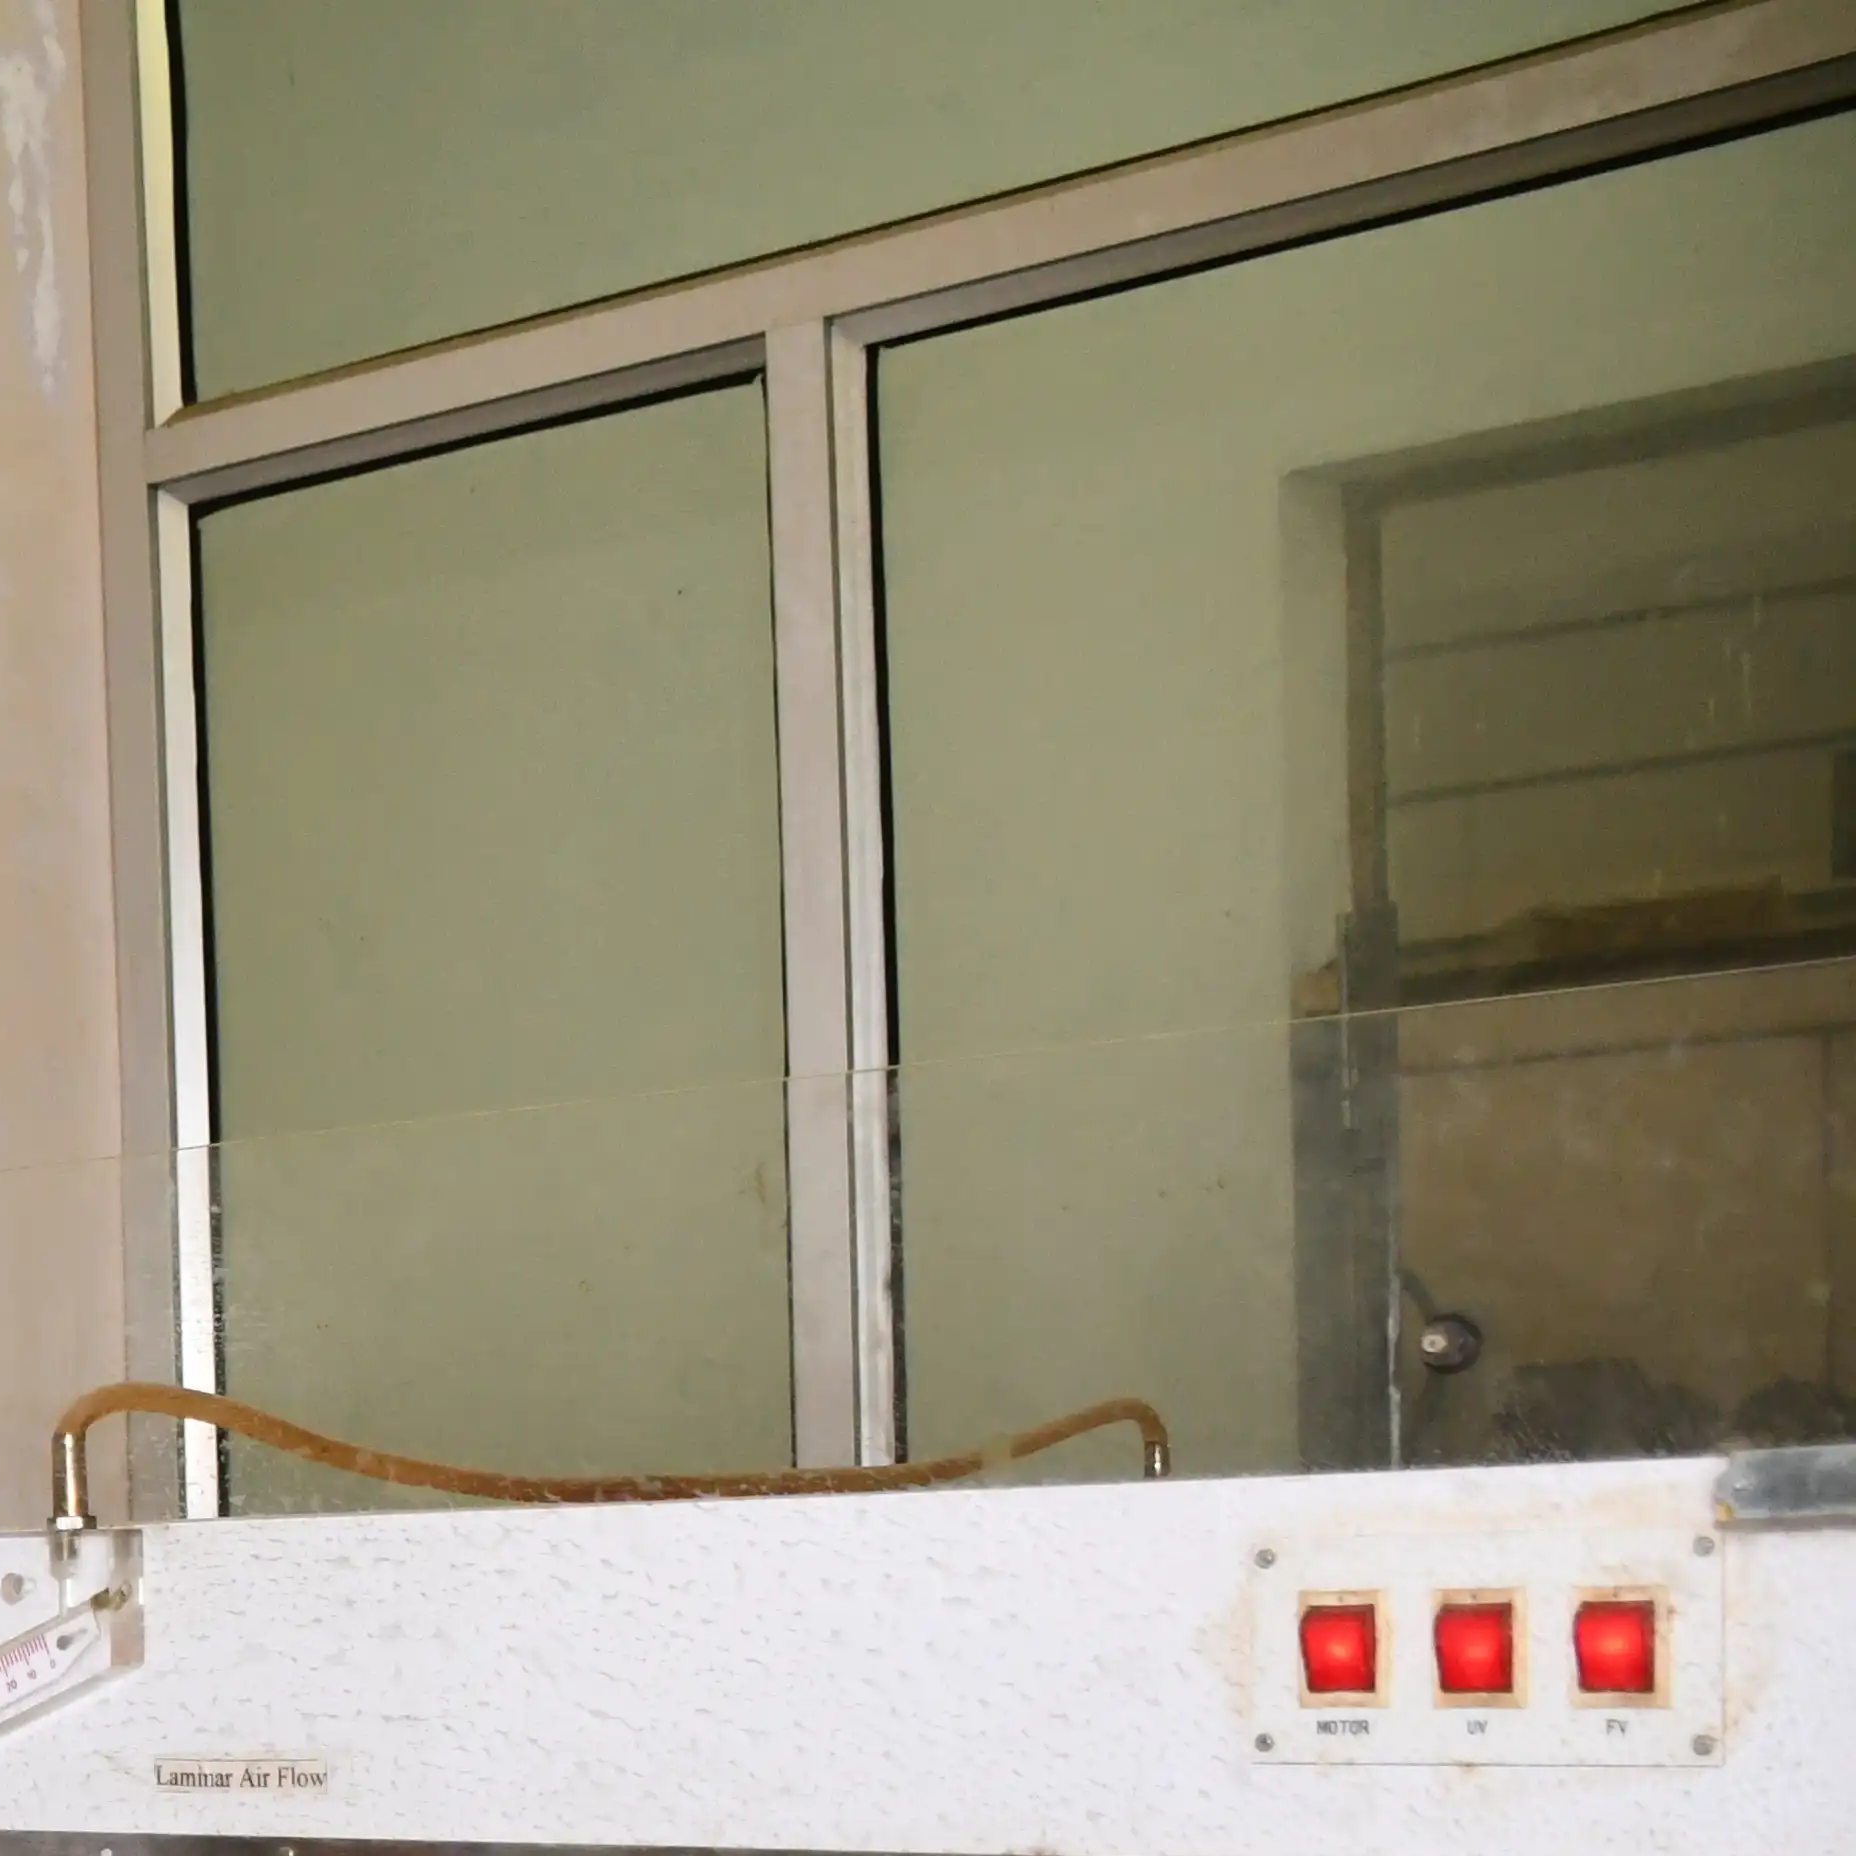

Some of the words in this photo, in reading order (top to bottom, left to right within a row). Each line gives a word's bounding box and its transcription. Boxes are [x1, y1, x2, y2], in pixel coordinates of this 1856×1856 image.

[50, 1659, 56, 1669] 0
[1316, 1720, 1370, 1735] MOTOR
[1467, 1720, 1488, 1735] UV
[240, 1766, 270, 1788] Air
[277, 1766, 326, 1788] Flow
